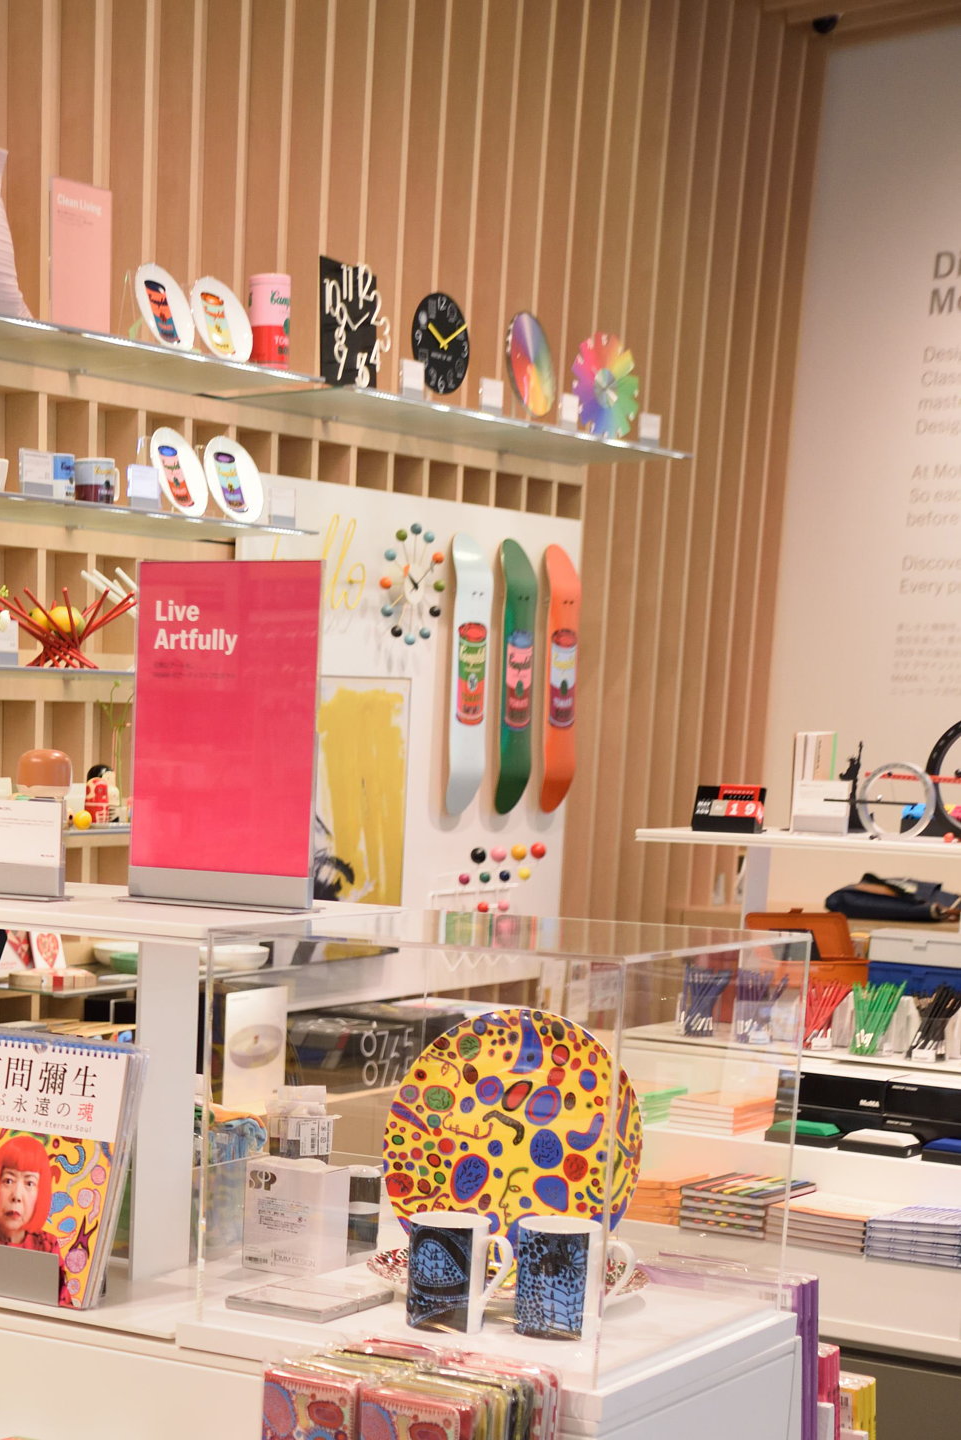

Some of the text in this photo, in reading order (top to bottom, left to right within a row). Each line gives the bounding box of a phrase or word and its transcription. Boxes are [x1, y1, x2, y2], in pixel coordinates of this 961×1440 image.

[933, 250, 961, 280] D
[929, 286, 961, 317] M
[155, 600, 200, 622] Live
[153, 628, 238, 656] Artfully
[32, 1118, 42, 1128] My
[45, 1119, 73, 1131] Eternal
[75, 1124, 92, 1134] Soul
